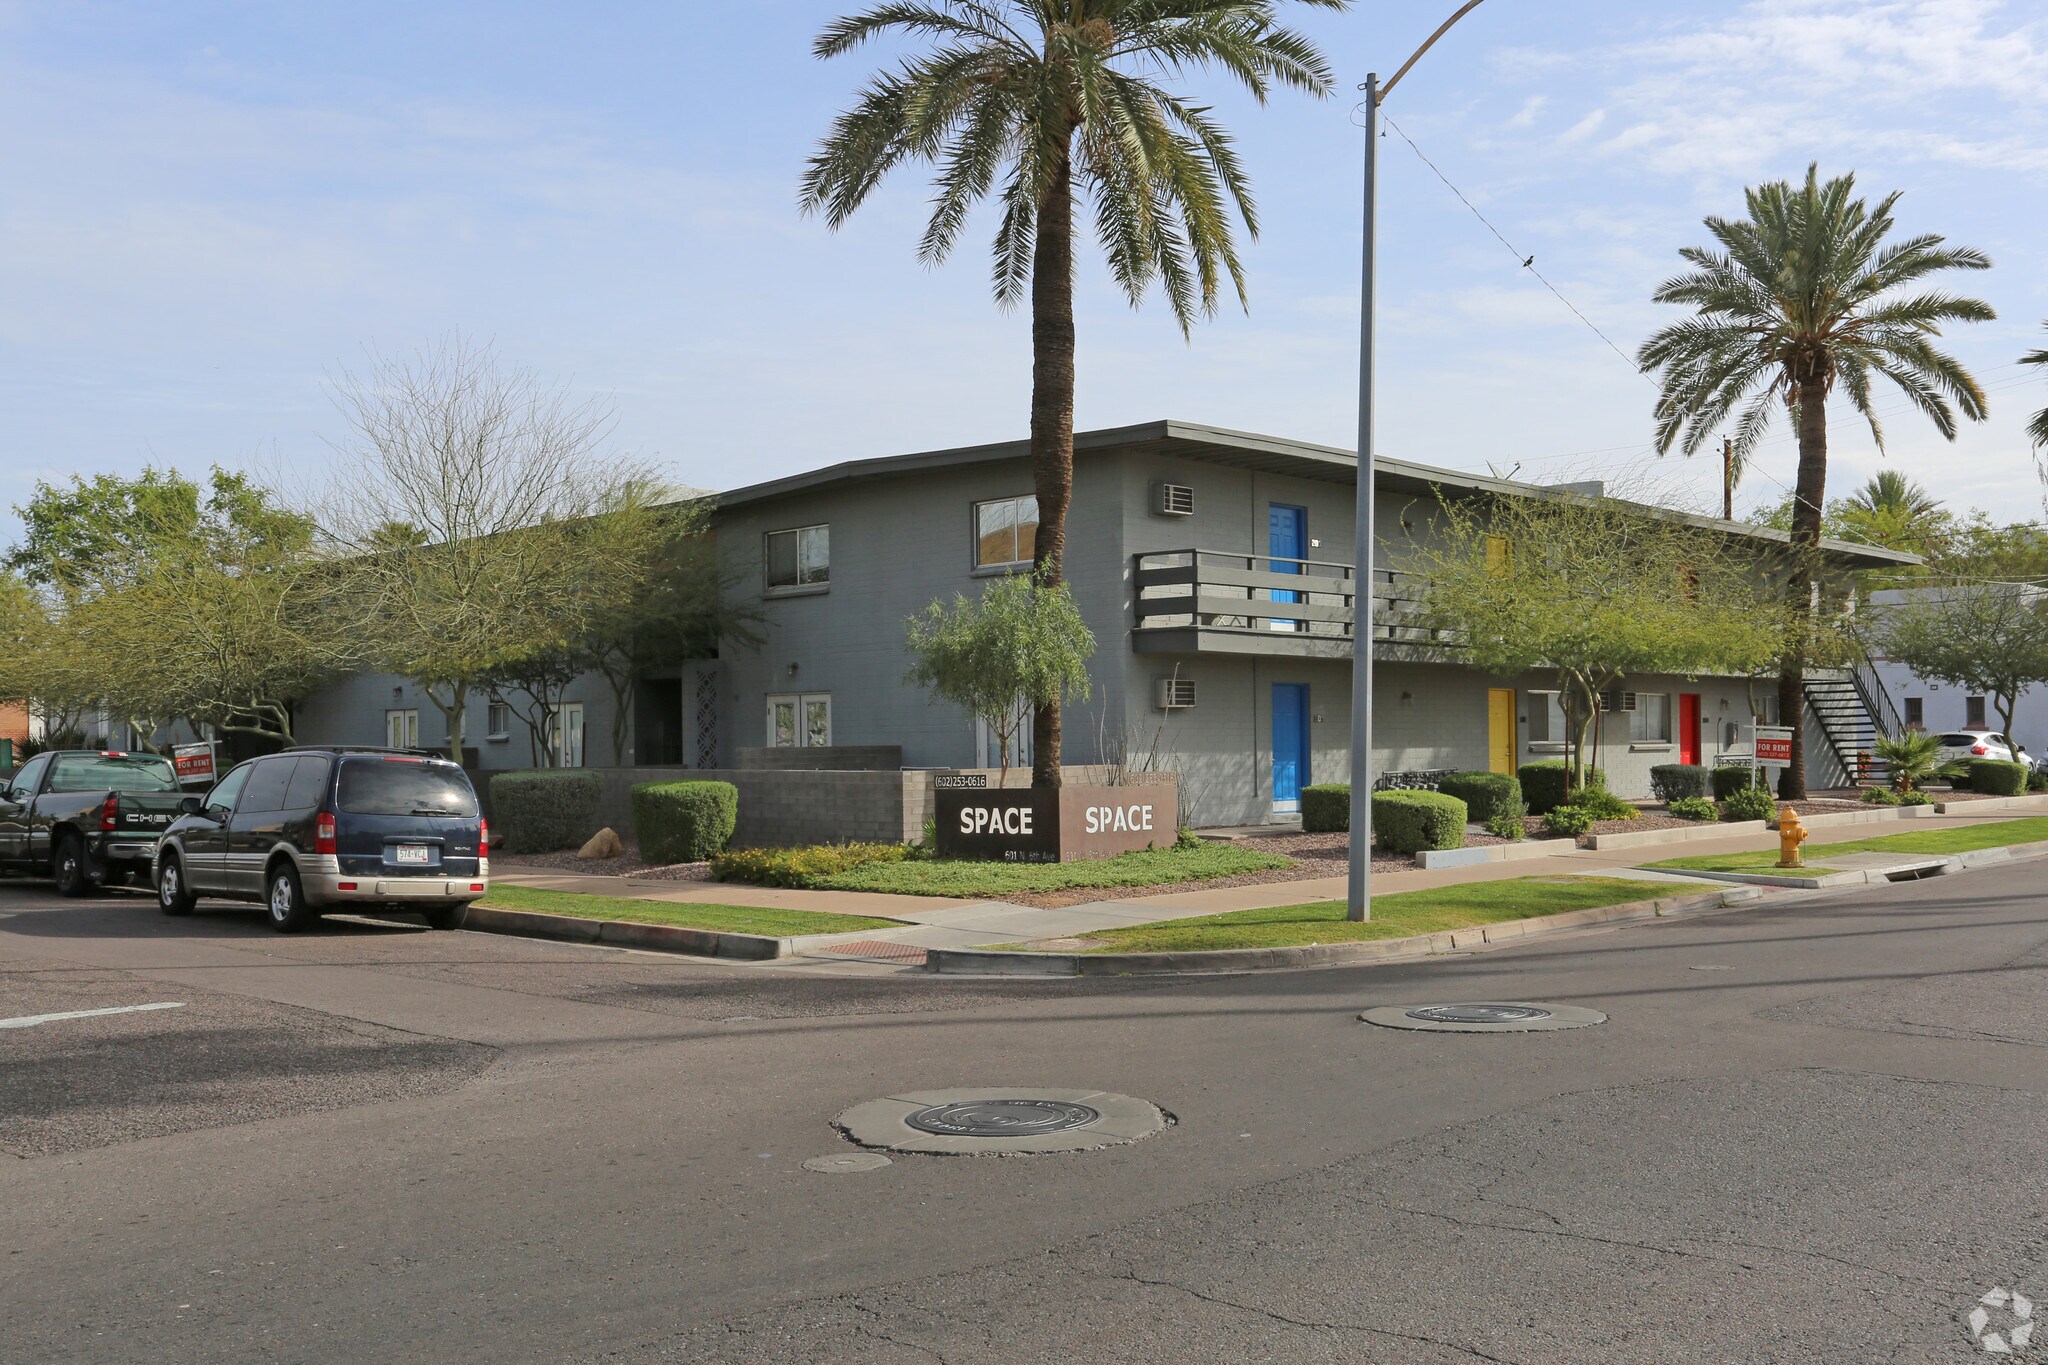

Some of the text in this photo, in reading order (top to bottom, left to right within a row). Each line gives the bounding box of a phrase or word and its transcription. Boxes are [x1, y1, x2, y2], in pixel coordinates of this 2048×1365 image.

[193, 759, 210, 767] RENT
[935, 776, 986, 787] (602)253-0616
[960, 807, 1033, 835] SPACE
[1085, 805, 1153, 834] SPACE
[1004, 850, 1017, 860] 601
[1042, 851, 1055, 861] Ave
